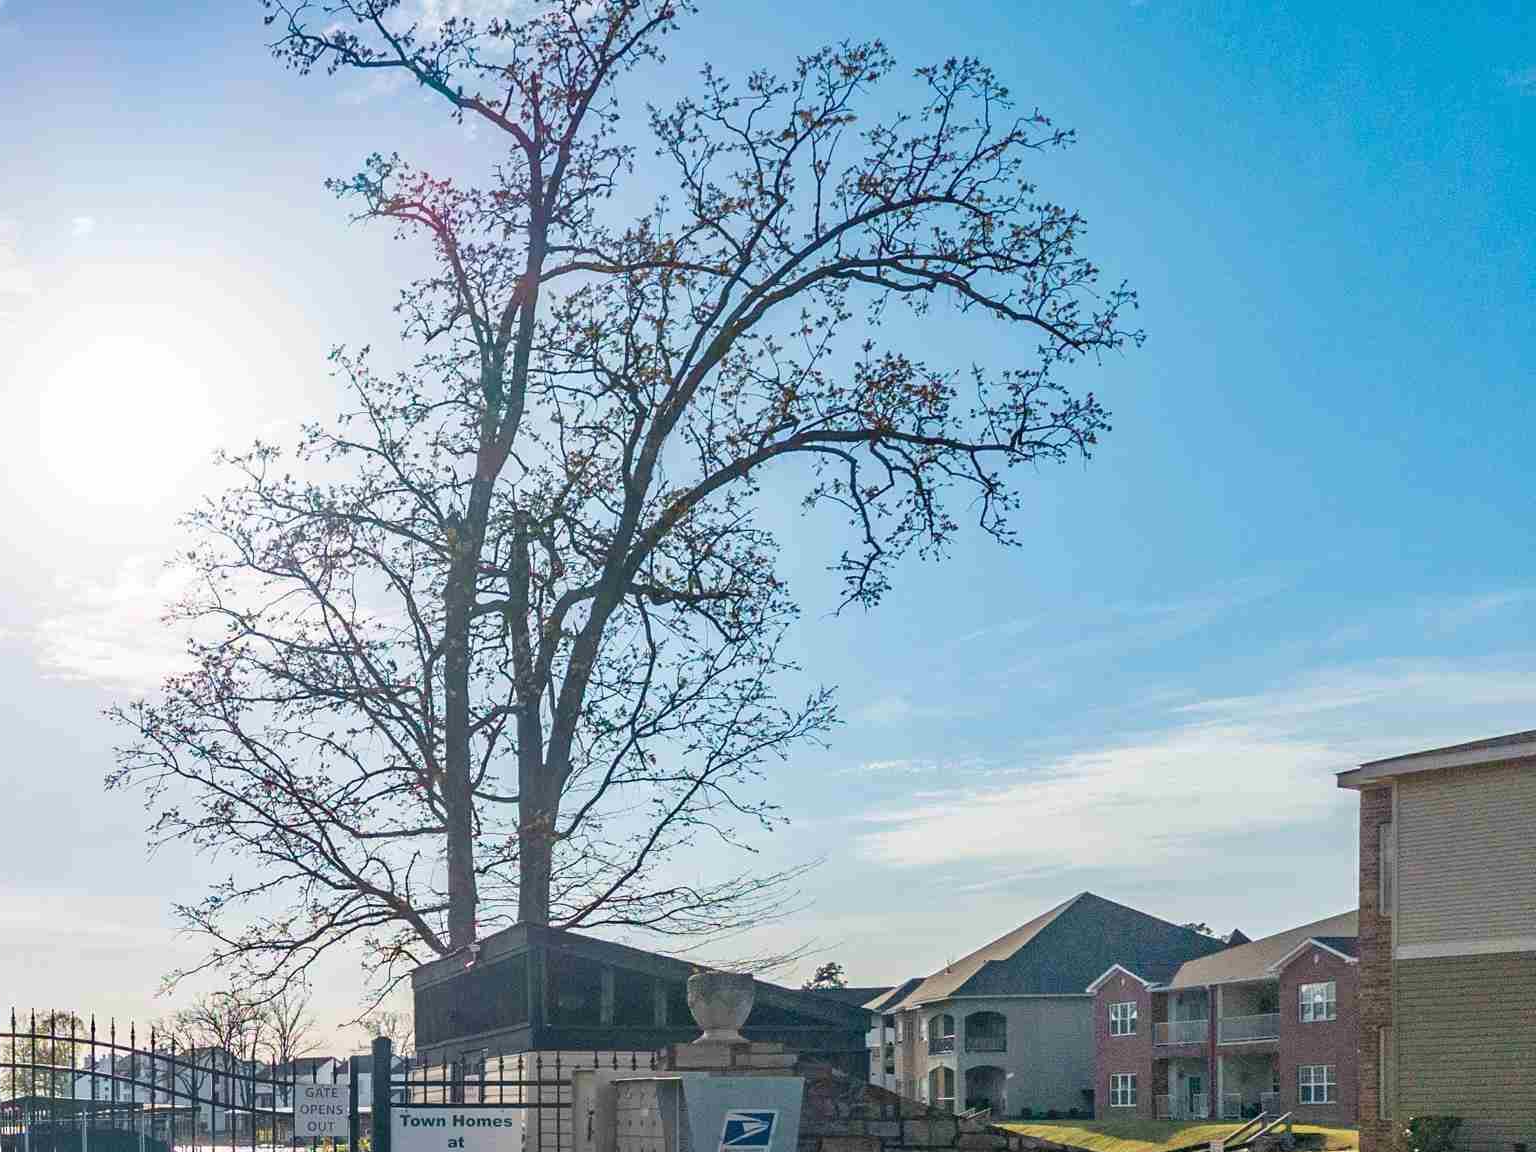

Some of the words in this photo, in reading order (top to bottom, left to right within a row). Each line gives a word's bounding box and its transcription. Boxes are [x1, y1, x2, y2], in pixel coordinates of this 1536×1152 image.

[305, 1087, 338, 1098] GATE
[300, 1104, 344, 1115] OPENS
[400, 1114, 446, 1127] Town
[453, 1114, 512, 1127] Homes
[307, 1121, 336, 1132] OUT
[447, 1136, 465, 1148] at
